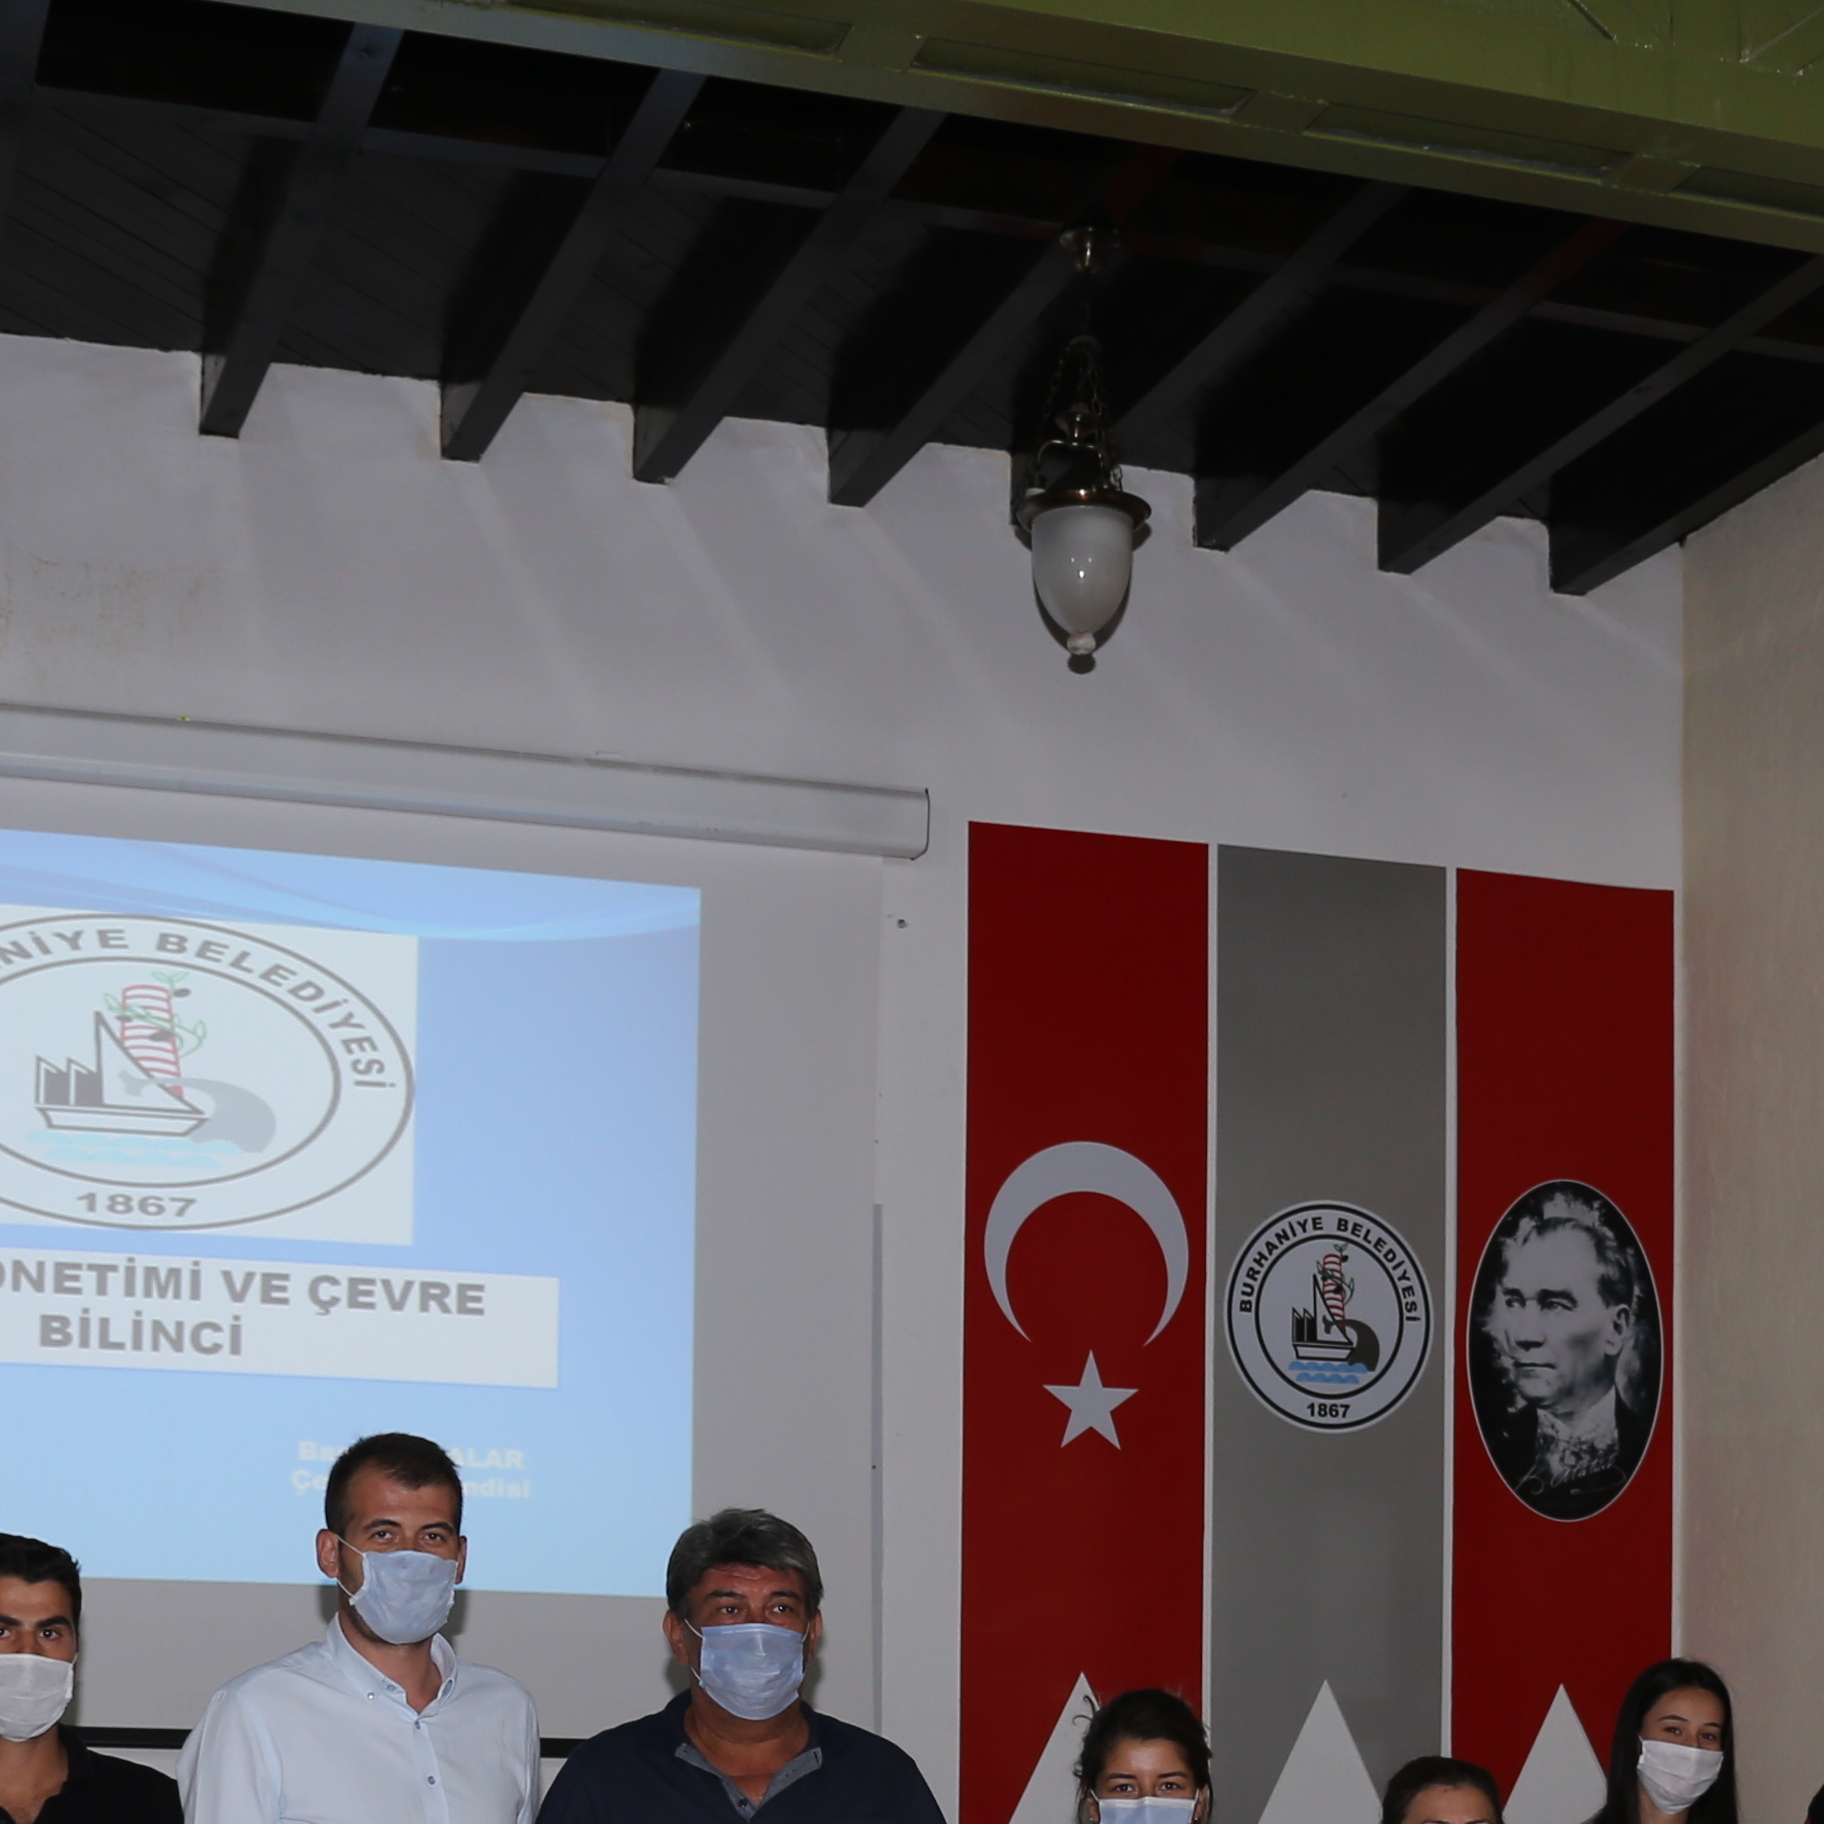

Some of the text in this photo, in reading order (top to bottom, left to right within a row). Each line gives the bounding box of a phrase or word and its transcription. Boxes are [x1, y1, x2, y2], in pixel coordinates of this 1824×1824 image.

[155, 932, 396, 1089] BELEDİYESİ
[76, 1191, 197, 1218] 1867
[220, 1269, 291, 1306] VE
[308, 1274, 486, 1317] ÇEVRE
[1239, 1216, 1421, 1323] BURHANİYE BELEDİYESİ
[39, 1307, 243, 1357] BİLİNCİ
[1306, 1402, 1351, 1419] 1867
